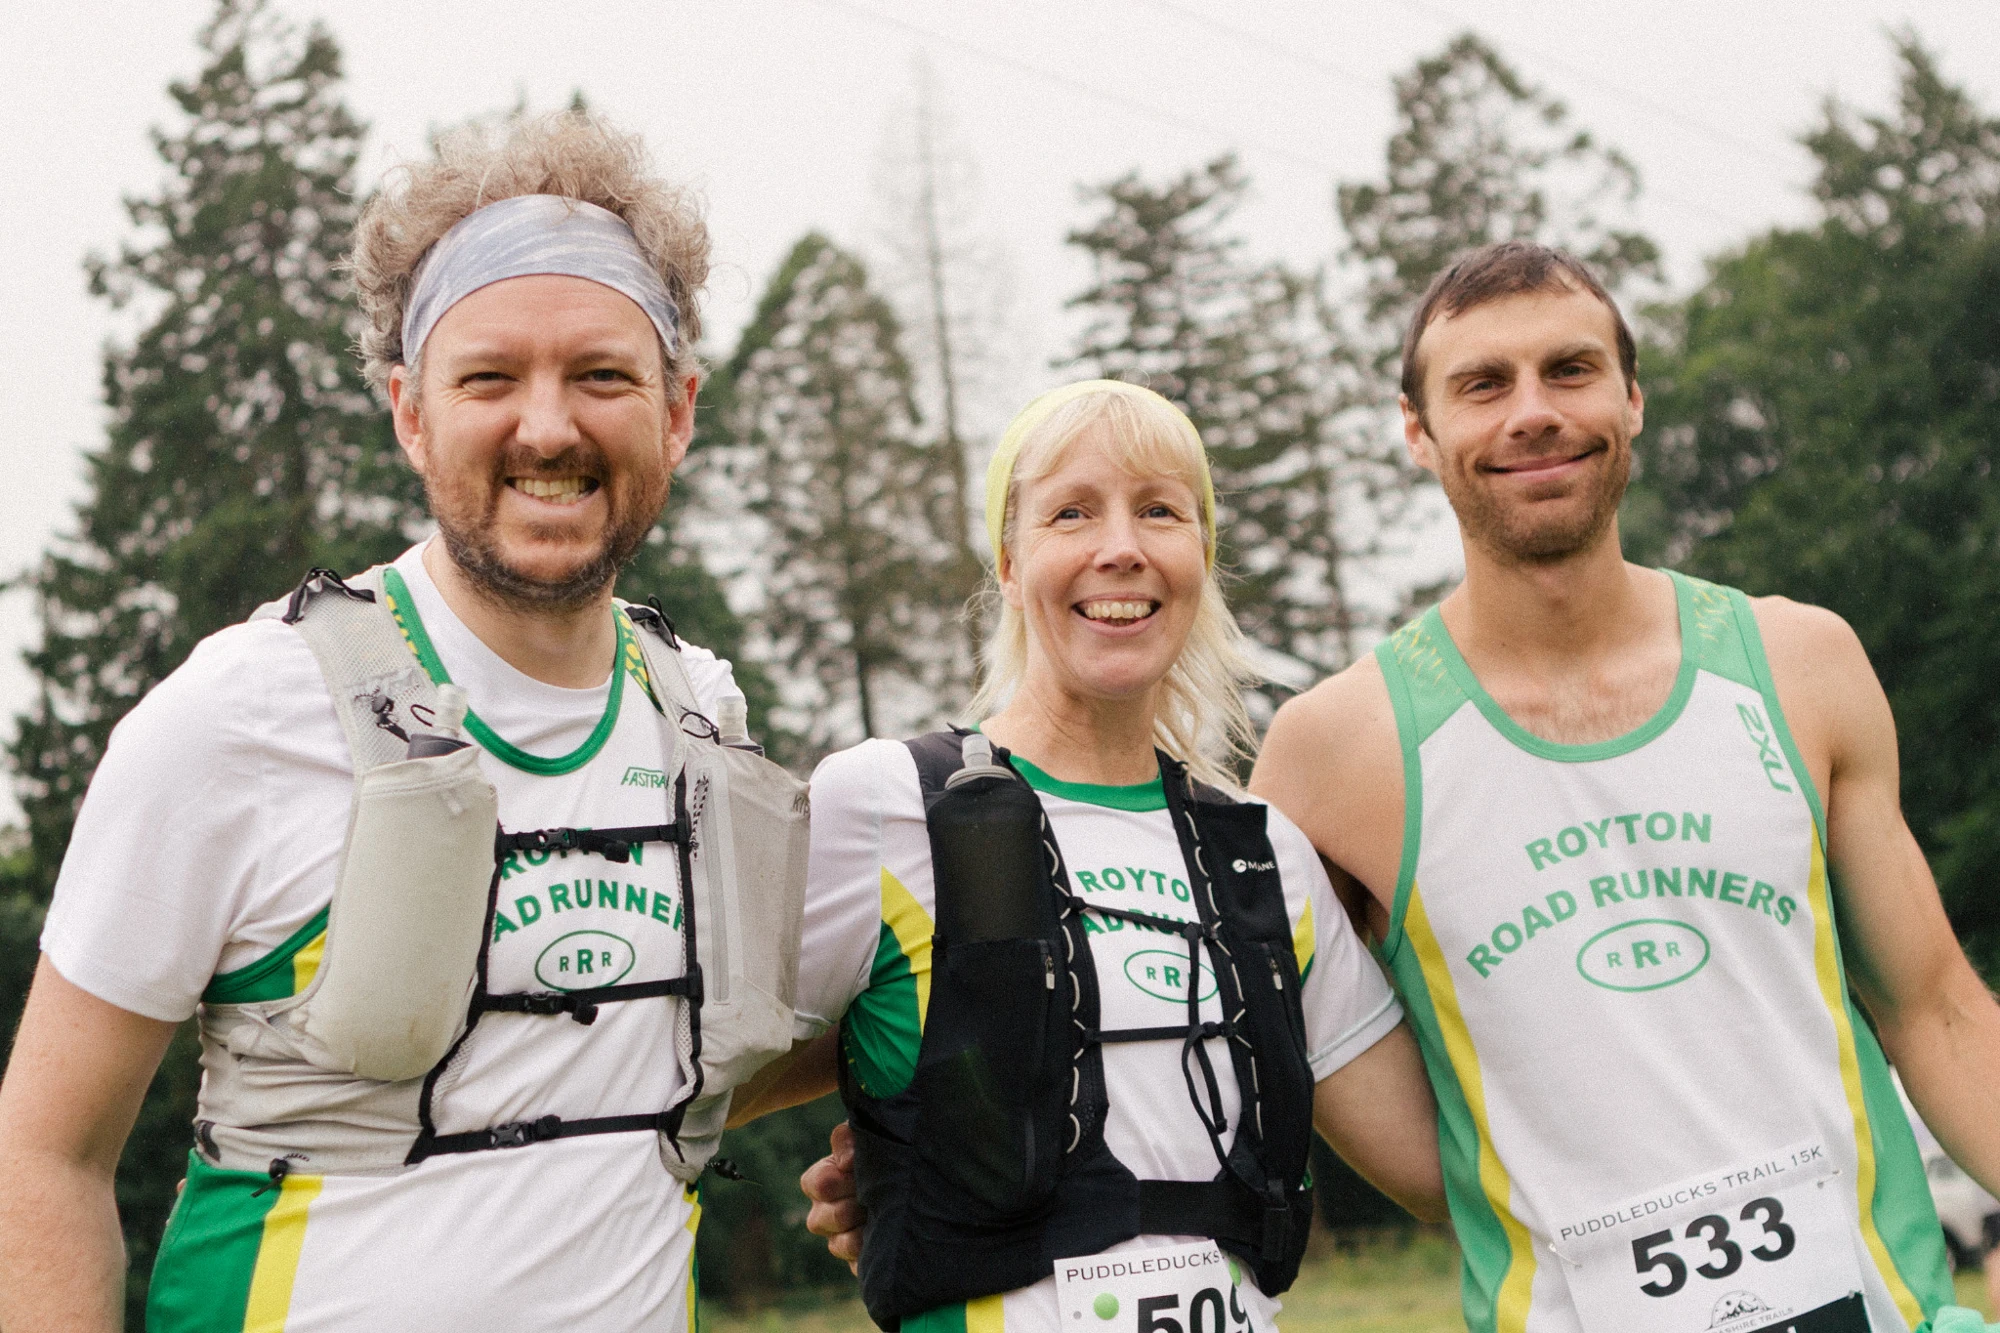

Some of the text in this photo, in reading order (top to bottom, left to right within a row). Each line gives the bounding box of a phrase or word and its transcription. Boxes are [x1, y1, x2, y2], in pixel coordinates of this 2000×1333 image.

[1736, 703, 1793, 794] 2XU
[1075, 866, 1191, 903] ROYTO
[1525, 811, 1712, 872] ROYTON
[1466, 866, 1797, 980] ROAD RUNNERS
[1560, 1145, 1824, 1241] PUDDLEDUCKS TRAIL 15K
[1066, 1249, 1221, 1283] PUDDLEDUCKS
[1631, 1196, 1797, 1298] 533
